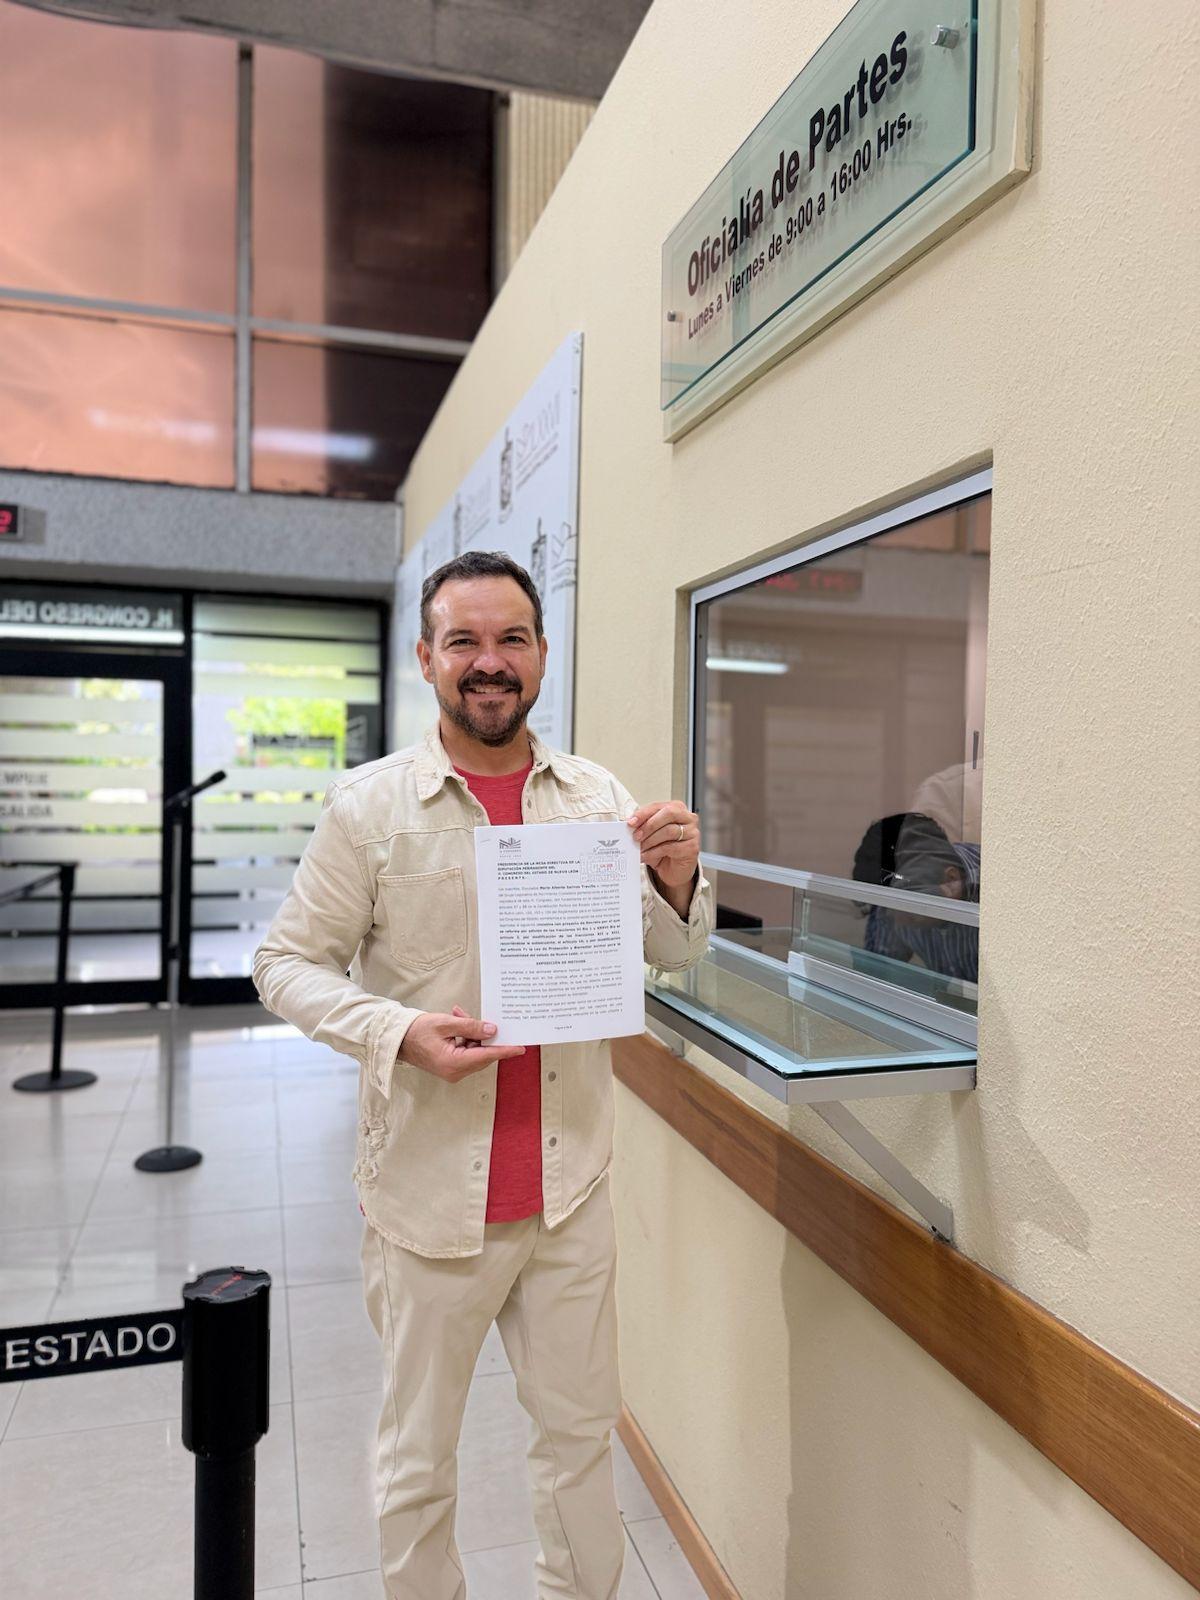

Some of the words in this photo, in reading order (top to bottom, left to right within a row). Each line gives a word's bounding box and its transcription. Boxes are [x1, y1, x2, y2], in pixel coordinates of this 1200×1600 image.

[688, 186, 764, 297] Oficialía
[771, 149, 799, 210] de
[809, 30, 908, 172] Partes
[688, 309, 715, 340] Lunes
[716, 294, 723, 311] a
[725, 250, 765, 303] Viernes
[768, 232, 783, 263] de
[785, 197, 813, 246] 9:00
[817, 192, 825, 216] a
[831, 145, 871, 203] 16:00
[877, 111, 912, 159] Hrs.
[5, 1322, 176, 1370] ESTADO
